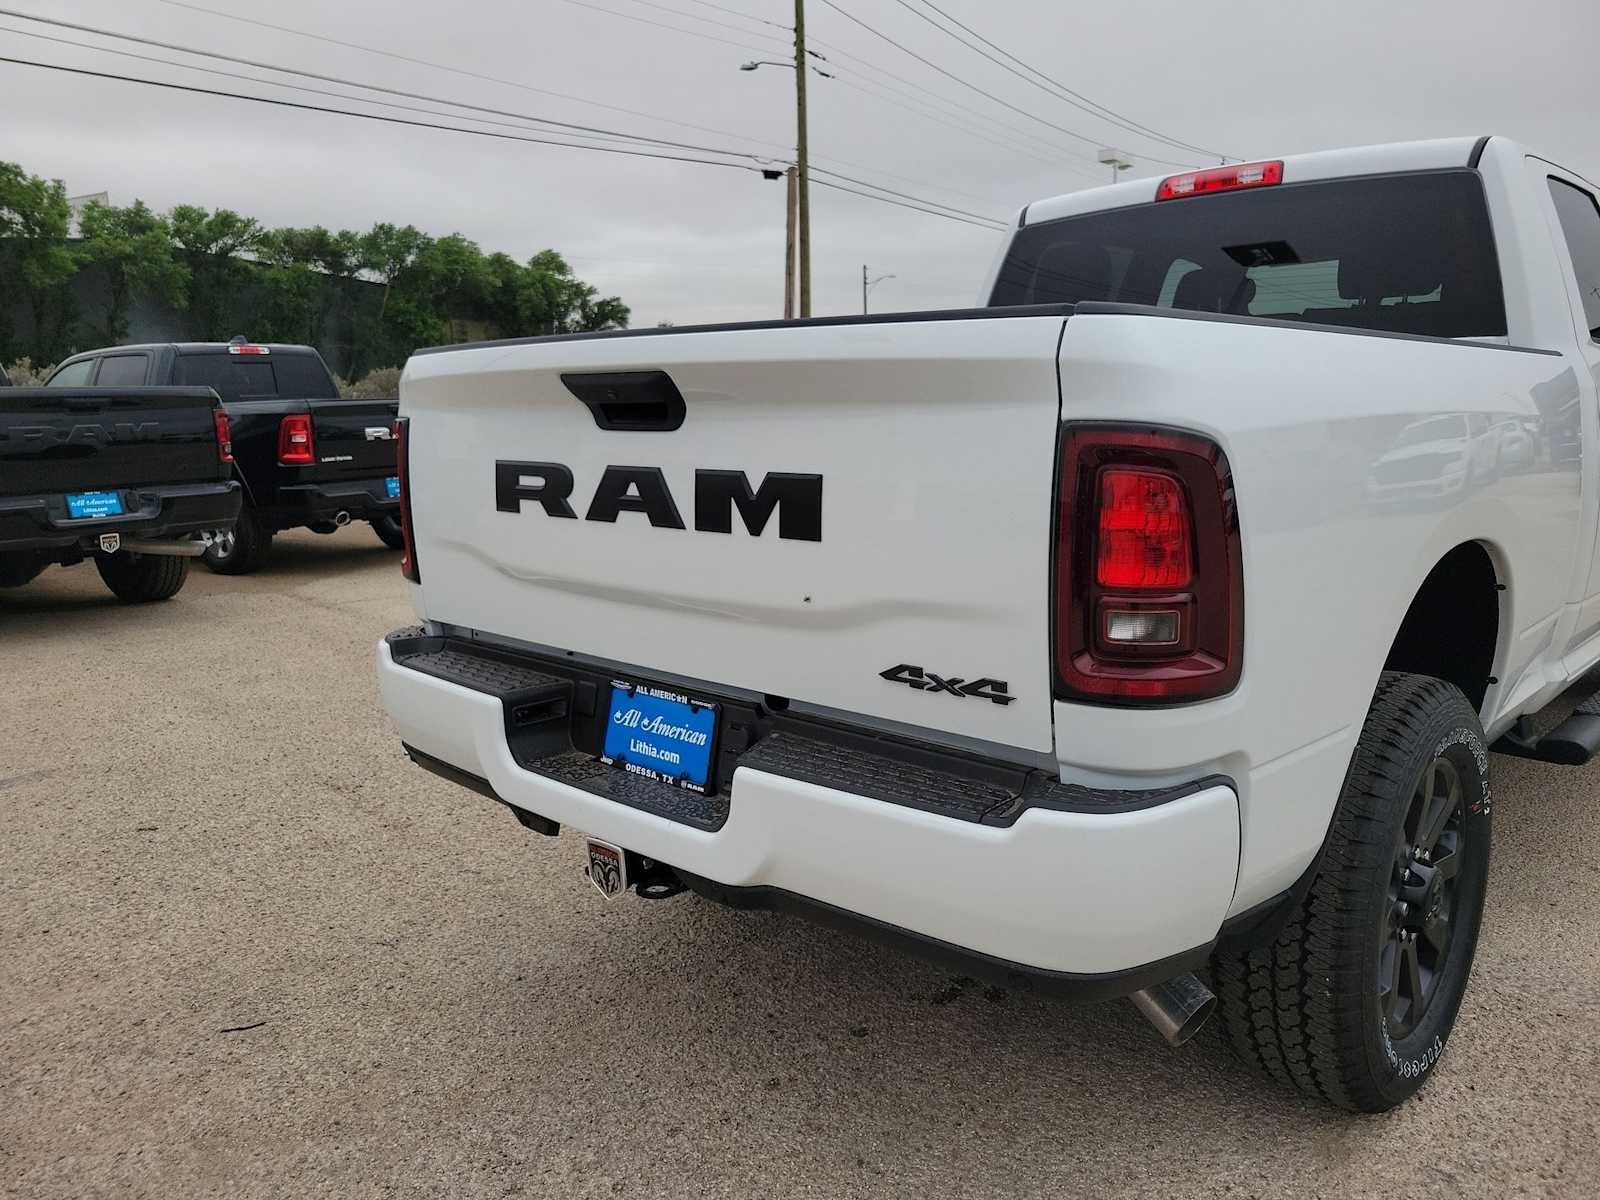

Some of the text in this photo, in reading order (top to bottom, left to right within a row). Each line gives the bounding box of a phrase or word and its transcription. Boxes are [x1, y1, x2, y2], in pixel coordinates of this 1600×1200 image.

[495, 459, 823, 542] RAM
[635, 685, 649, 695] ALL
[879, 663, 1016, 706] 4x4
[613, 708, 707, 746] All American
[630, 738, 680, 765] Lithia.com
[625, 762, 675, 785] ODESSA, TX
